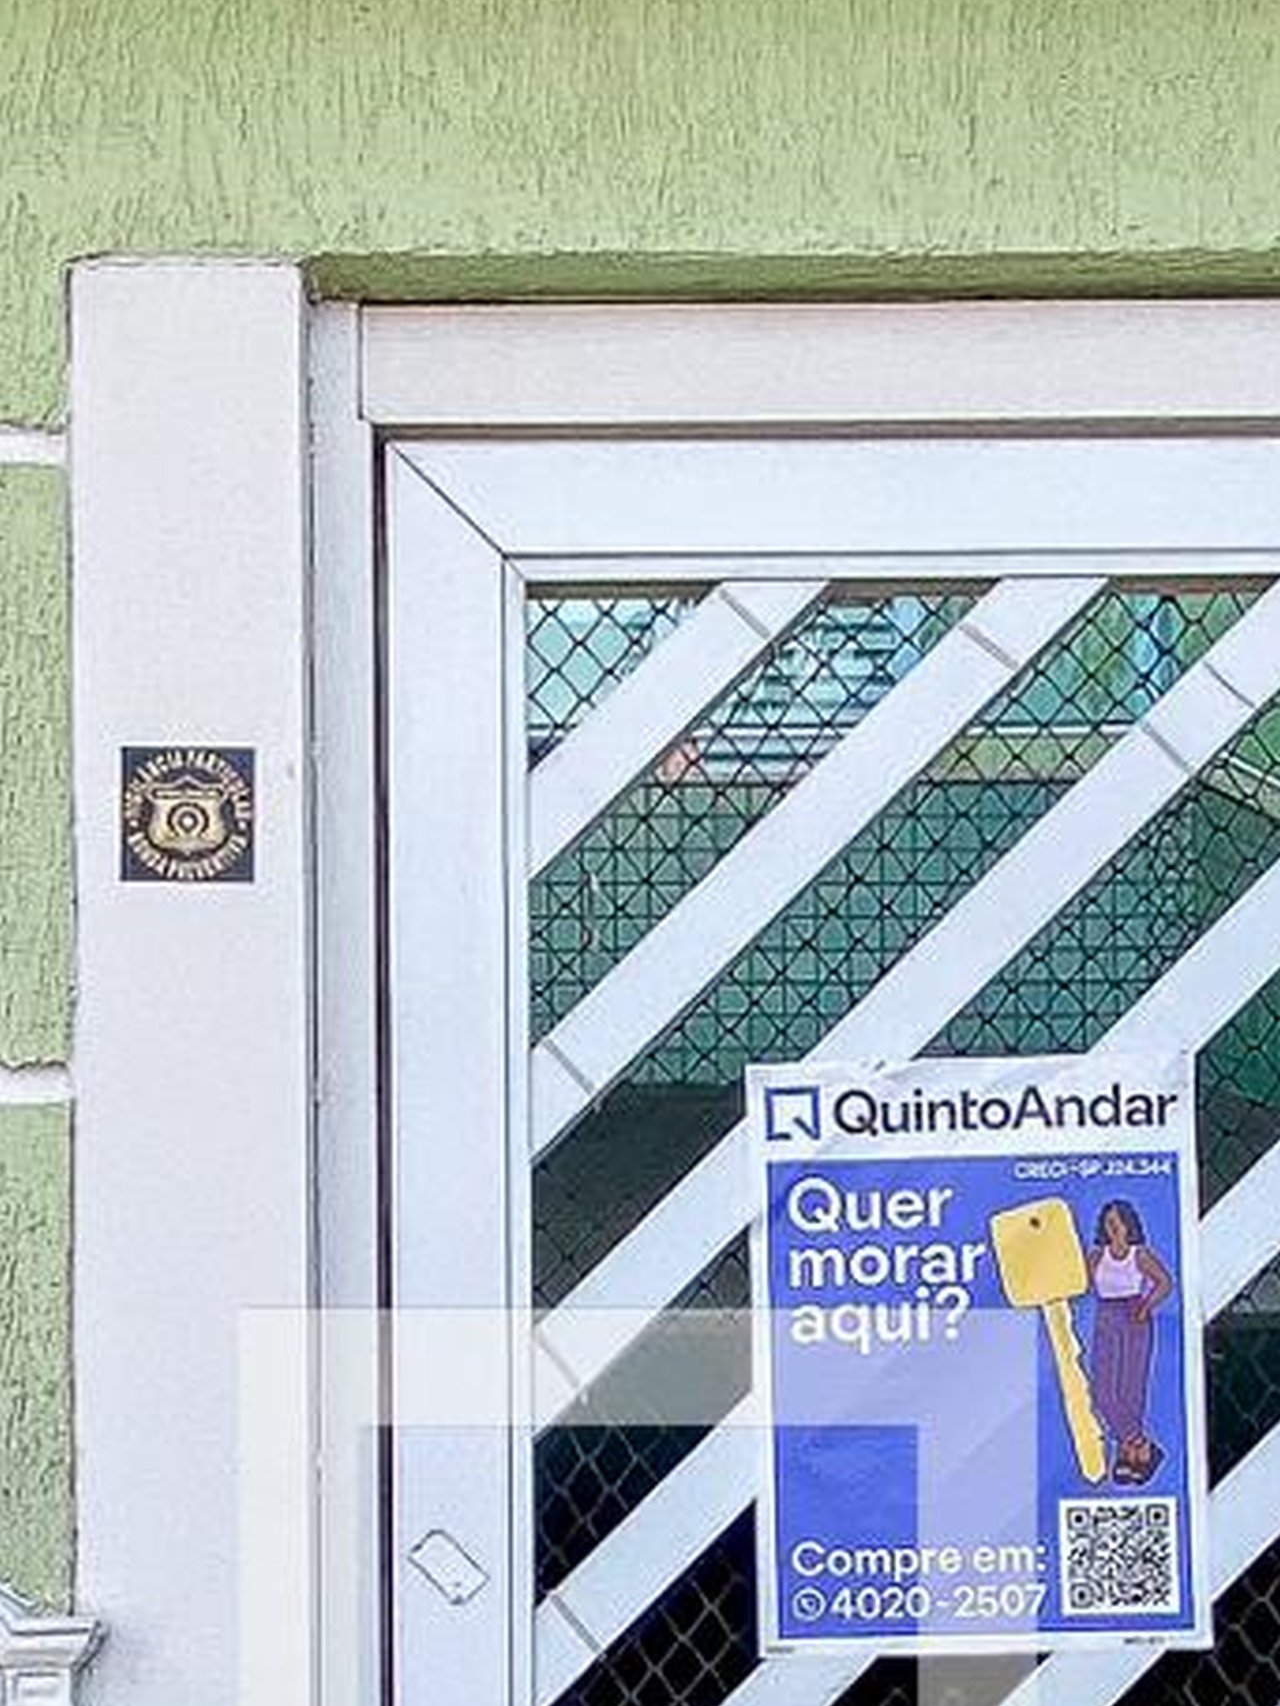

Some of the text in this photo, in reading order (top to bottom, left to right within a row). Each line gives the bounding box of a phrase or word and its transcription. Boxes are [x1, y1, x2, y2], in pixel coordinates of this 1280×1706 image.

[832, 1083, 1178, 1137] QuintoAndar
[787, 1176, 954, 1233] Quer
[788, 1243, 987, 1288] morar
[790, 1285, 971, 1356] aqui?
[791, 1541, 1047, 1582] Compre em:
[830, 1583, 1048, 1620] 4020-2507
